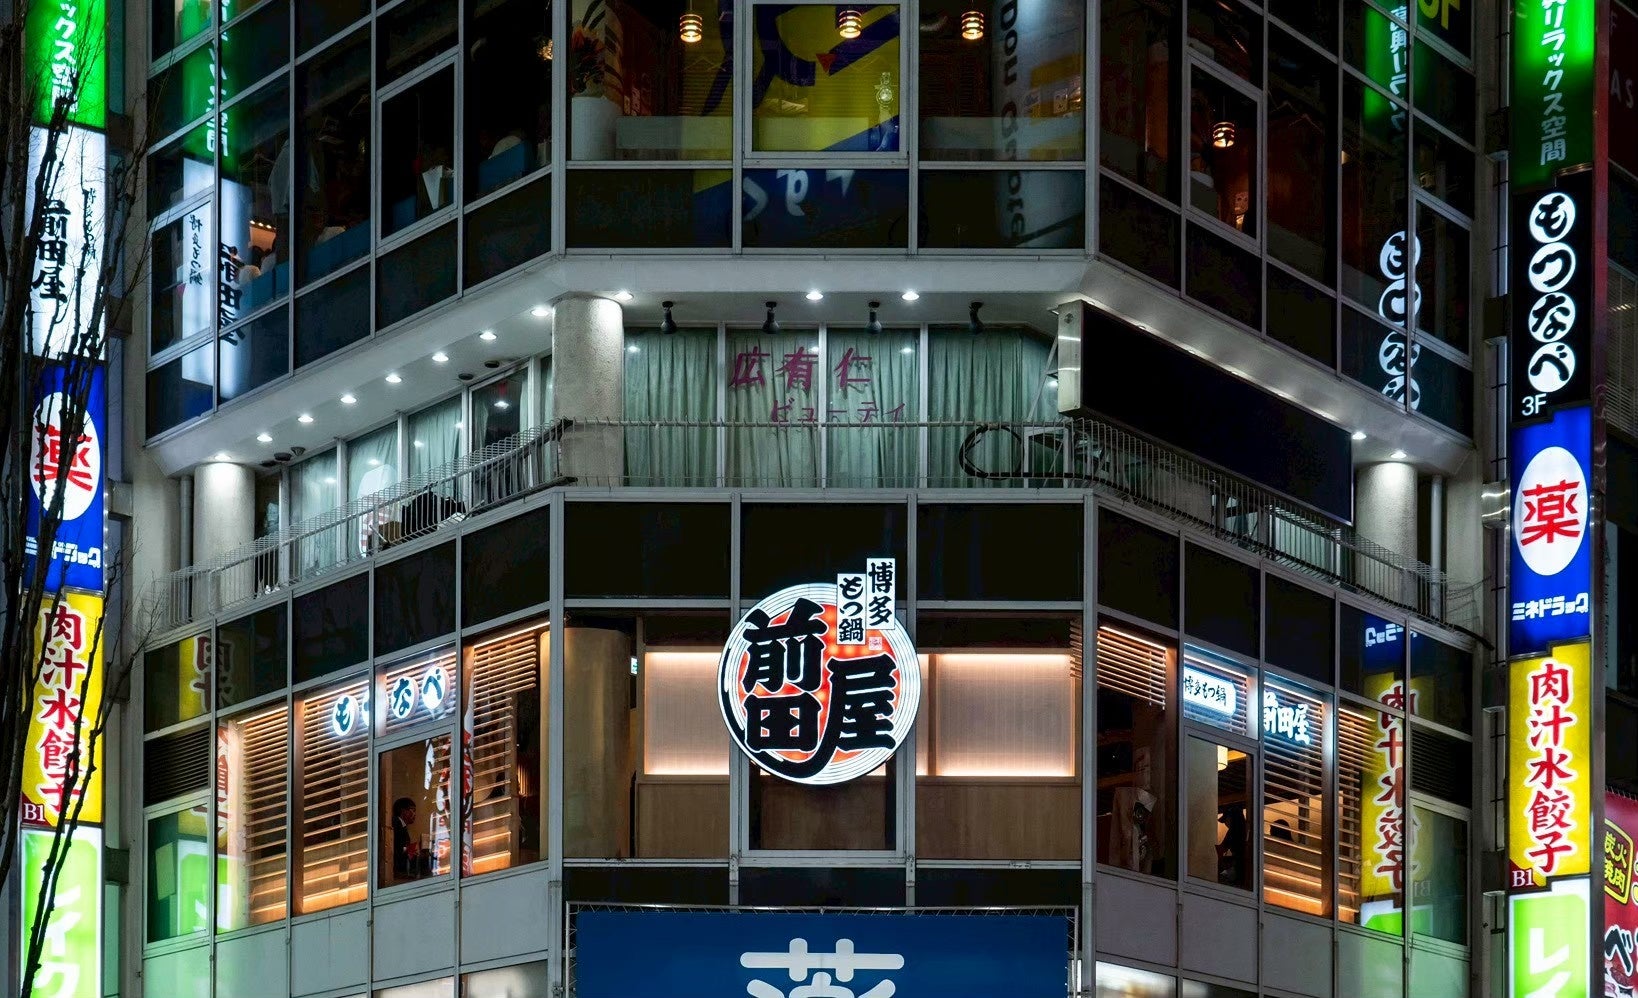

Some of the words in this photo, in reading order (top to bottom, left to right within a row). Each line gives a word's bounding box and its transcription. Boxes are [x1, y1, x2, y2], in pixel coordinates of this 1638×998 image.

[1539, 0, 1567, 166] リラックス空間
[32, 199, 71, 303] 前田屋
[1529, 192, 1576, 393] もつなべ
[1521, 393, 1547, 417] 3F
[1520, 479, 1581, 547] 薬
[838, 576, 865, 643] もつ鍋
[867, 561, 894, 627] 博多
[40, 605, 85, 812] 肉汁水餃子
[740, 597, 899, 779] 前田屋
[1529, 662, 1576, 873] 肉汁水餃子
[23, 802, 47, 822] B1
[1511, 869, 1535, 887] B1
